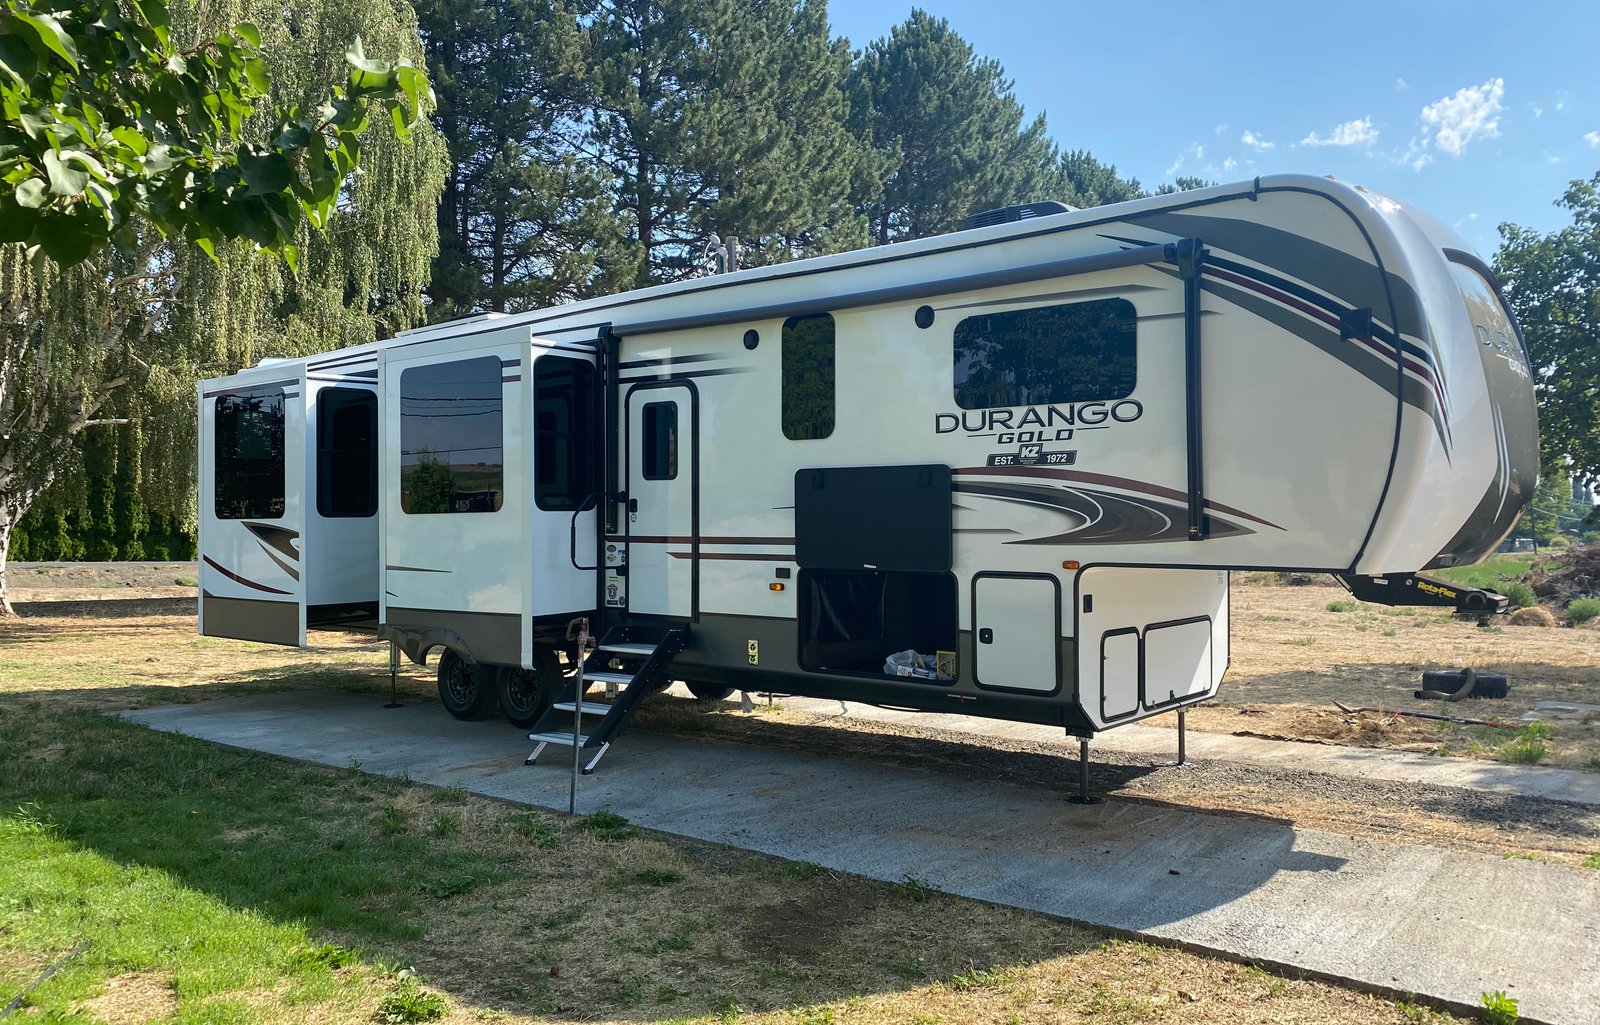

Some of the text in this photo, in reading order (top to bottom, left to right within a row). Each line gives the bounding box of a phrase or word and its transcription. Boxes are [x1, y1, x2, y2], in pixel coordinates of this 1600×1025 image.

[935, 399, 1144, 434] DURANGO
[997, 428, 1074, 445] GOLD
[994, 456, 1014, 466] EST.
[1046, 453, 1068, 463] 1972
[1020, 446, 1040, 458] KZ
[1417, 581, 1456, 598] Rota-Flex
